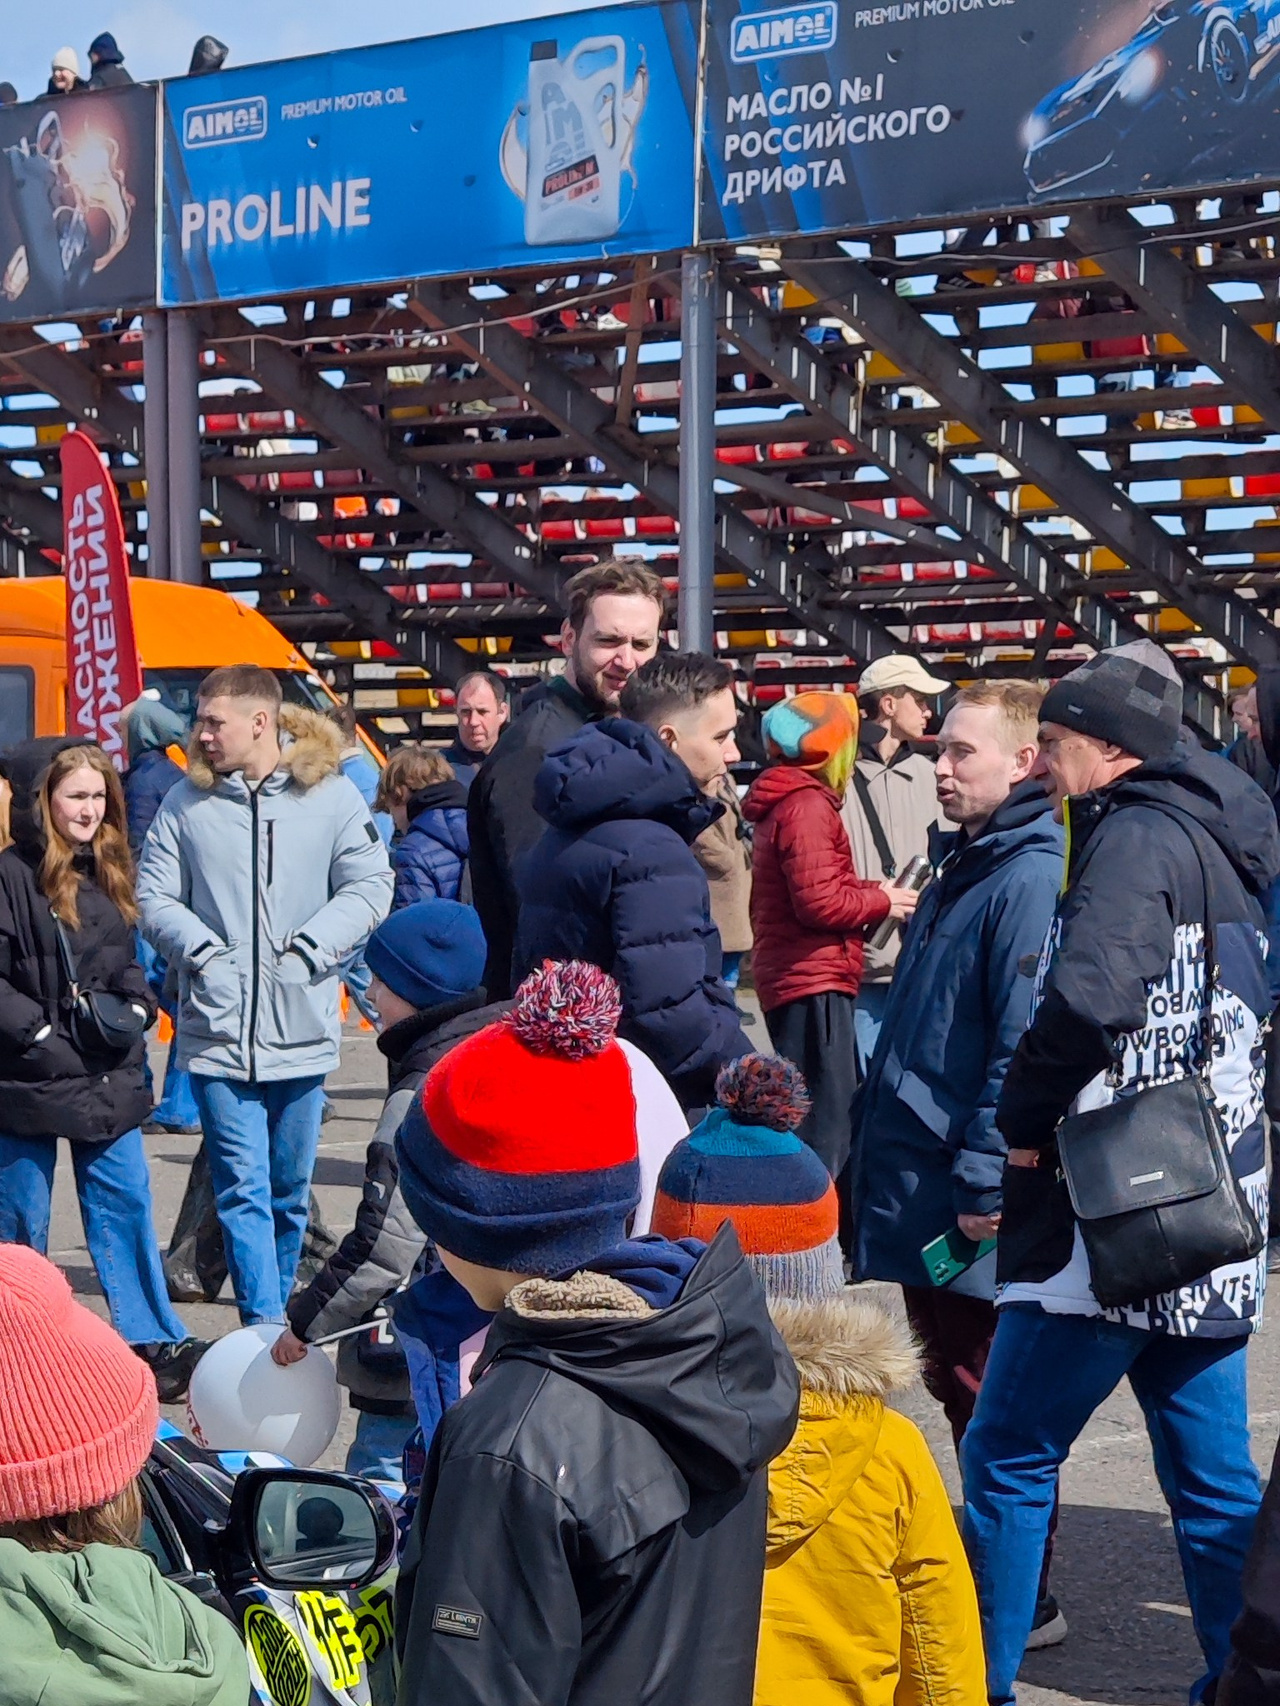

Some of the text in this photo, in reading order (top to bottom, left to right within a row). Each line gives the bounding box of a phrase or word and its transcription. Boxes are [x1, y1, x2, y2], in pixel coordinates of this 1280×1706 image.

[736, 12, 831, 53] AIMOL
[854, 4, 921, 28] PREMIUM
[187, 106, 263, 140] AIMOL
[281, 86, 408, 120] PREMIUM MOTOR OIL
[726, 82, 831, 123] МАСЛО
[724, 104, 951, 161] РОССИЙСКОГО
[722, 158, 847, 206] ДРИФТА
[181, 177, 371, 250] PROLINE
[68, 493, 98, 739] АСНОСТЬ
[86, 483, 122, 752] ИЖЕНИИ
